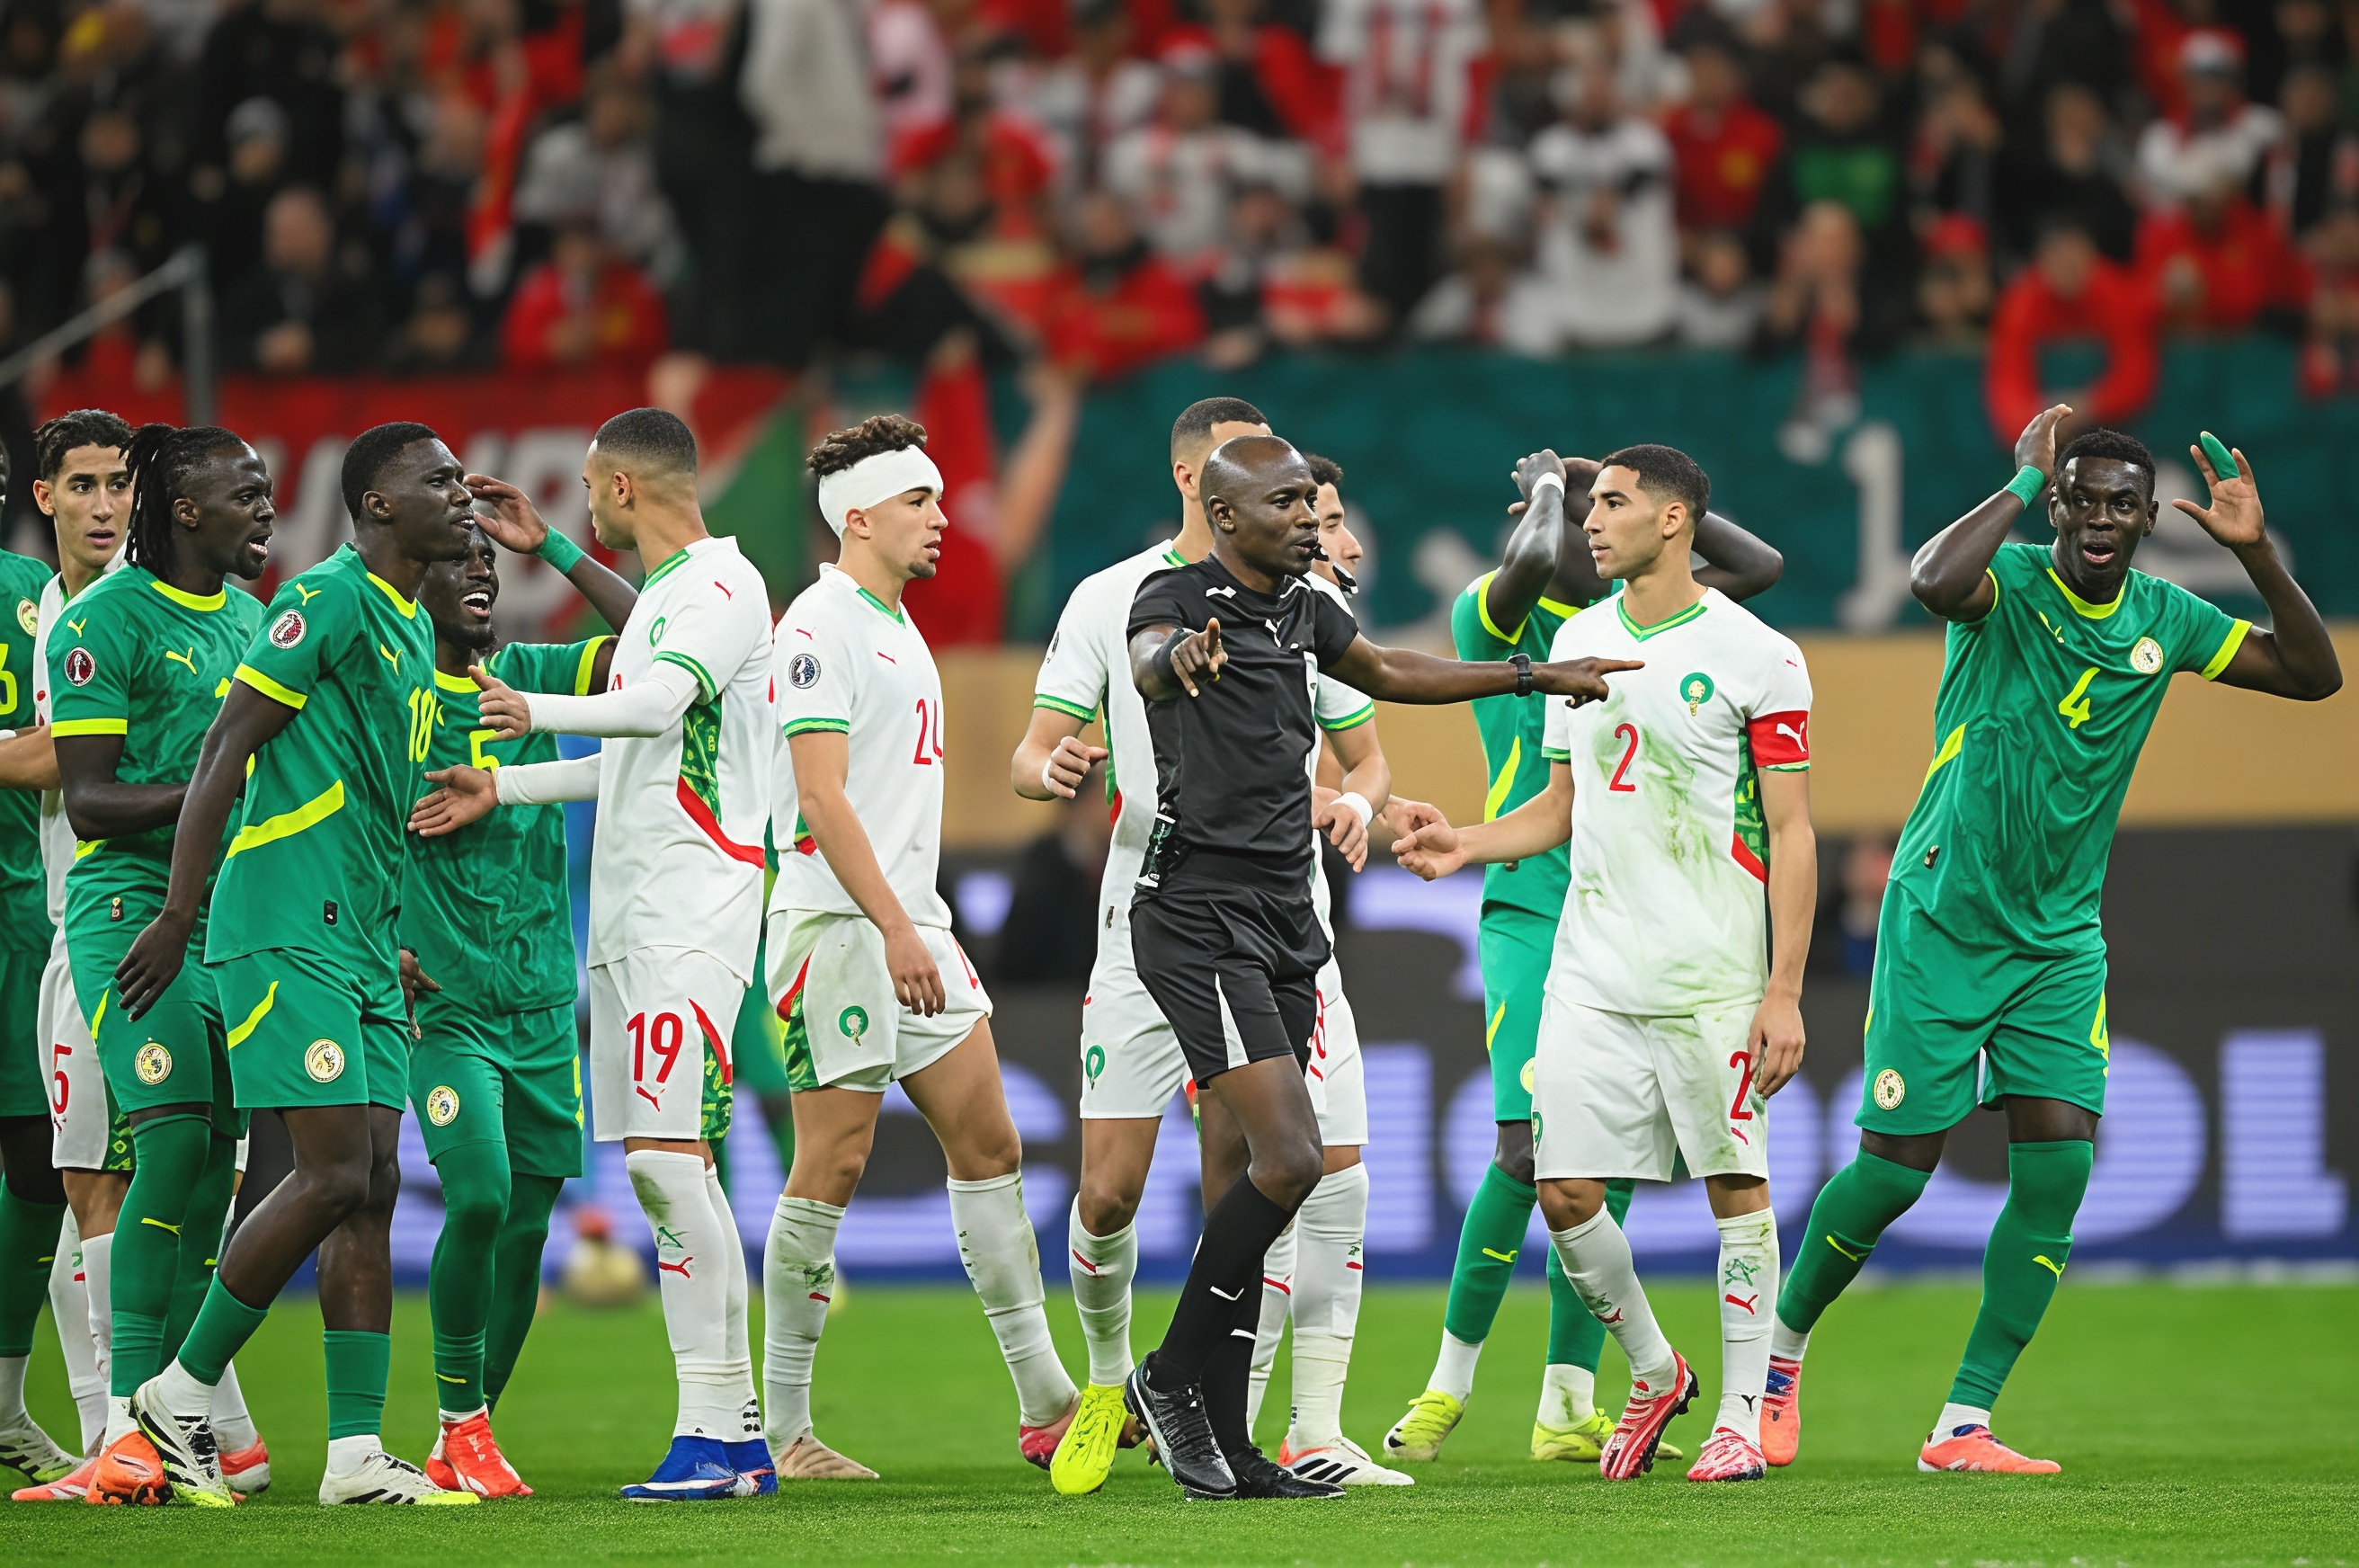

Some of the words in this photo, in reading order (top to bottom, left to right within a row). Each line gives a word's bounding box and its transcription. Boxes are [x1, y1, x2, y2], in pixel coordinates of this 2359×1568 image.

[2059, 667, 2100, 729] 4
[1609, 723, 1638, 792] 2
[53, 1044, 72, 1115] 5
[627, 1011, 683, 1083] 19
[1729, 1050, 1755, 1121] 2
